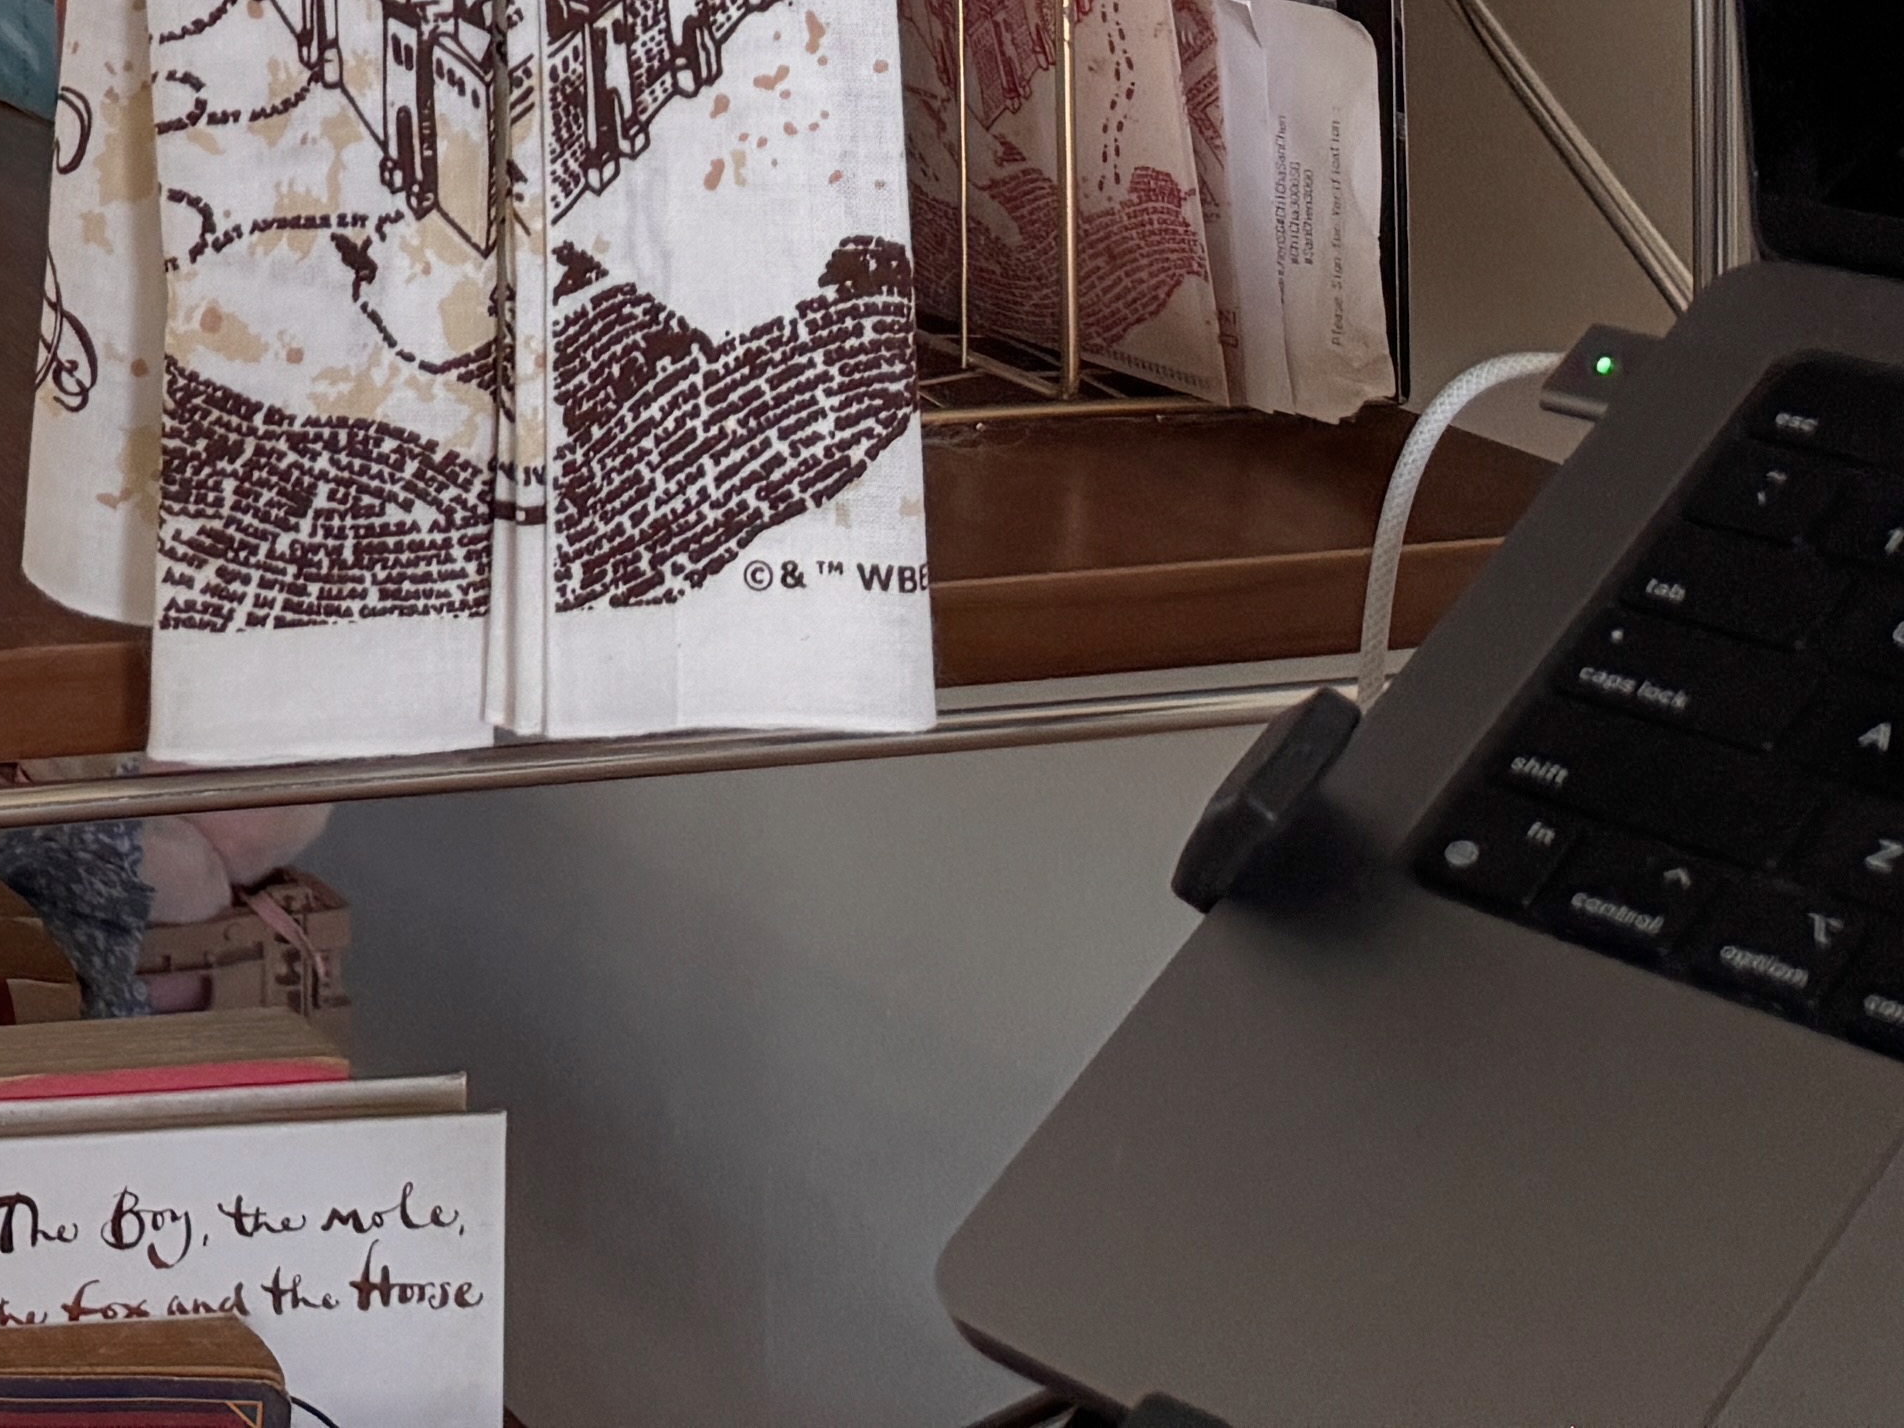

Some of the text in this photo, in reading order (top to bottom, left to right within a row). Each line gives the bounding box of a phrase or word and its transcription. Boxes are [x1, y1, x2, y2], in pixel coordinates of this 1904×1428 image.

[1329, 120, 1342, 217] Verification
[1330, 257, 1342, 290] Sign
[1331, 298, 1344, 347] Please
[1775, 412, 1819, 432] esc
[1645, 577, 1686, 604] tab
[1578, 662, 1689, 711] caps lock
[1857, 722, 1892, 752] A
[1510, 754, 1570, 787] shift
[1527, 820, 1556, 847] fn
[1865, 839, 1904, 873] Z
[1570, 888, 1666, 936] control
[1719, 944, 1809, 989] option
[101, 1185, 210, 1270] Boy,
[218, 1194, 307, 1237] the
[321, 1181, 466, 1238] mole,
[166, 1282, 252, 1319] and
[261, 1266, 342, 1316] the
